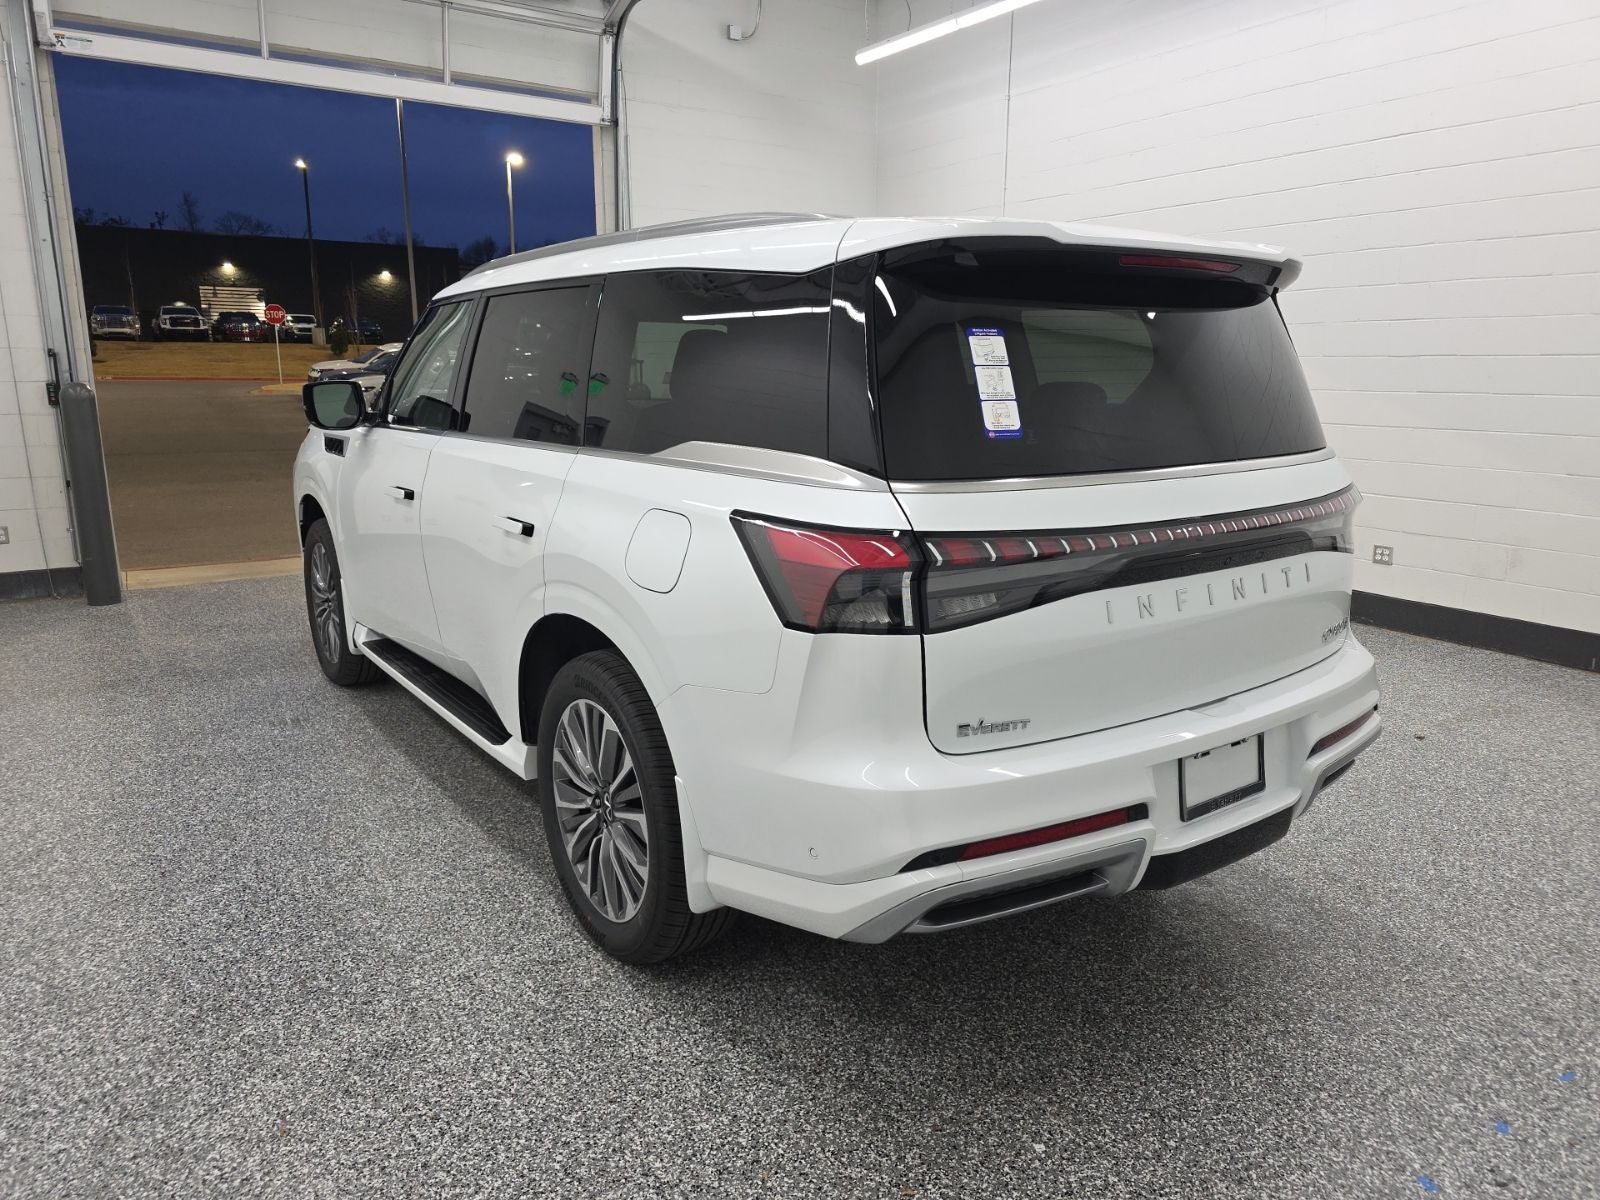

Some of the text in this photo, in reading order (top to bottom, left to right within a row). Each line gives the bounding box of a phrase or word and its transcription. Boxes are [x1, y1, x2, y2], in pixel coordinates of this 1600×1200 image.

[266, 310, 284, 319] STOP
[1106, 562, 1310, 624] INFINITI
[957, 718, 1030, 738] EVERETT
